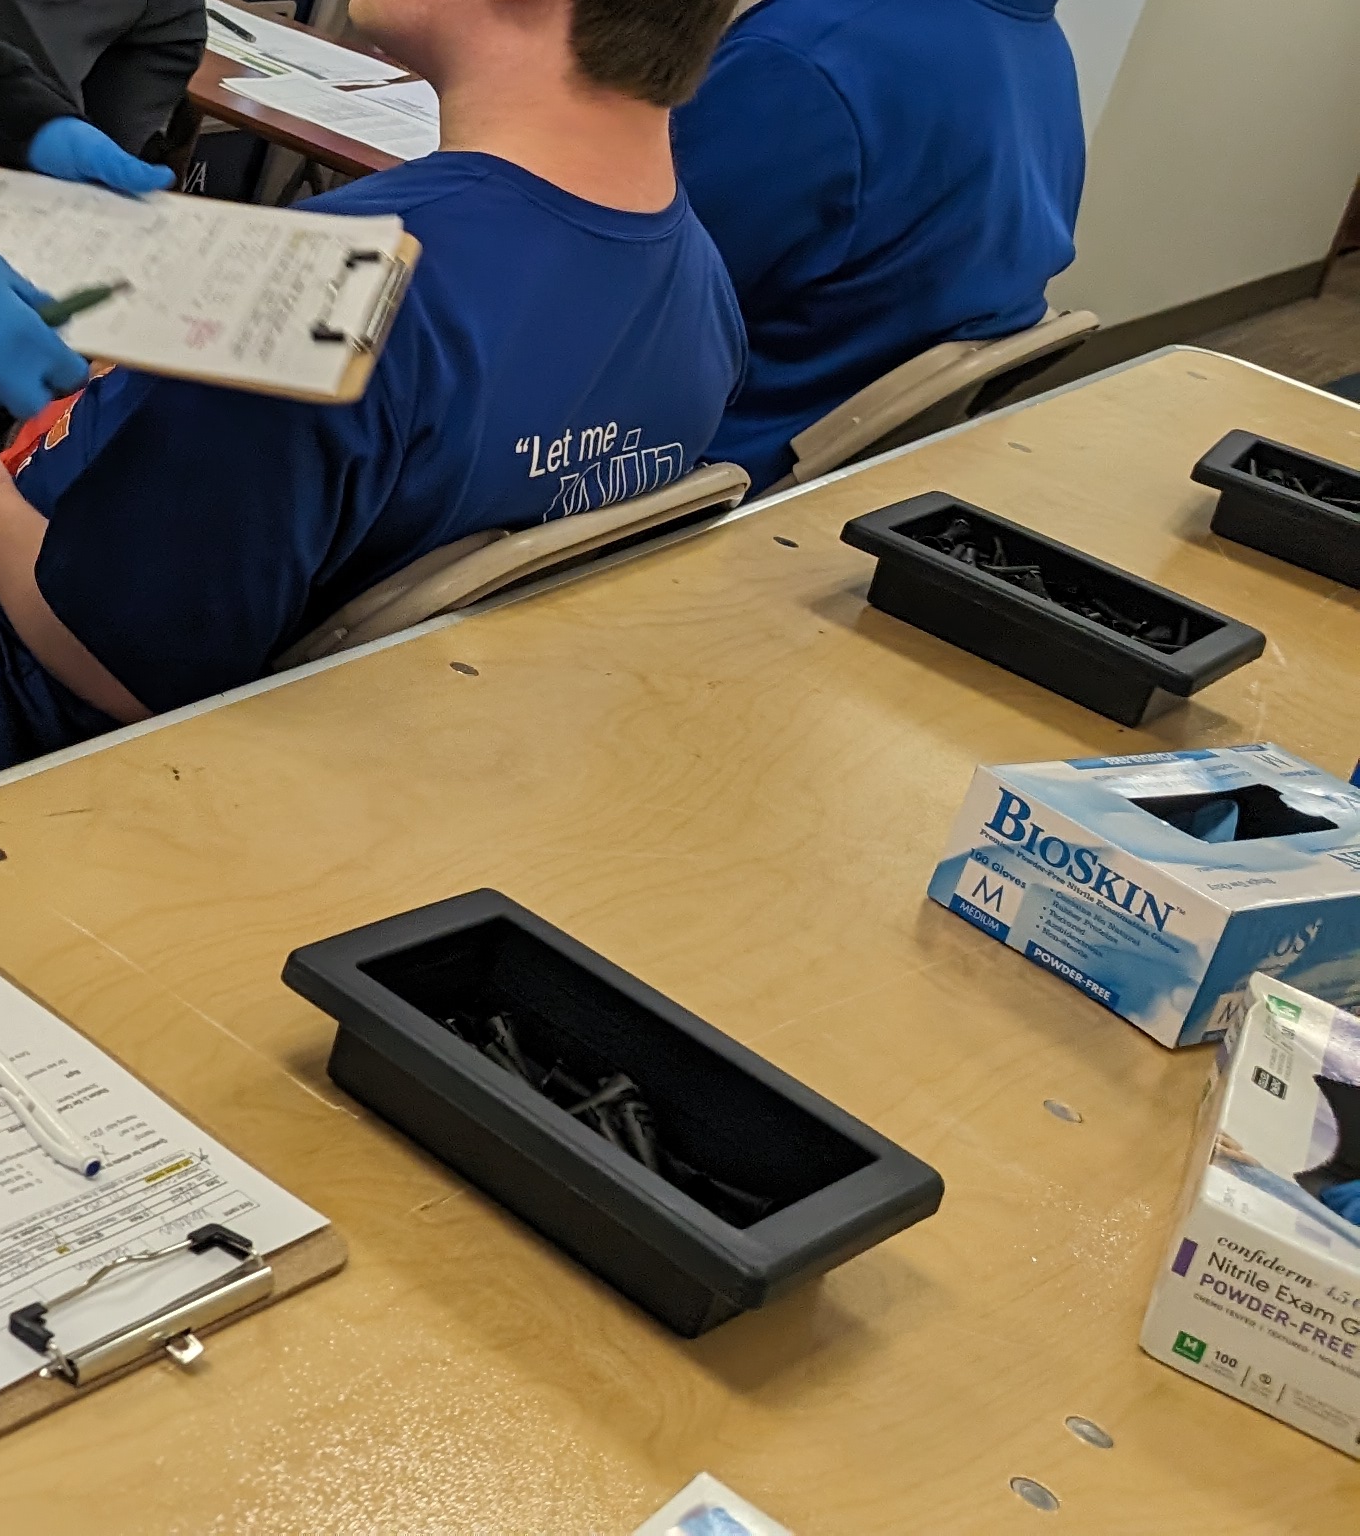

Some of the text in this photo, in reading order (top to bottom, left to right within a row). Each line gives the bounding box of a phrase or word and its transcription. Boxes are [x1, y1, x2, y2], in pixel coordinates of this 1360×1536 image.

[578, 421, 618, 462] me
[991, 862, 1027, 890] Gloves
[1066, 881, 1095, 903] Nitrile
[971, 875, 1004, 913] M
[959, 901, 1000, 933] MEDIUM
[1033, 946, 1112, 1002] POWDER-FREE
[1207, 1251, 1270, 1293] Nitrile
[1275, 1284, 1336, 1325] Exam
[1199, 1272, 1357, 1359] POWDER-FREE
[1182, 1335, 1199, 1352] M
[1214, 1349, 1239, 1369] 100
